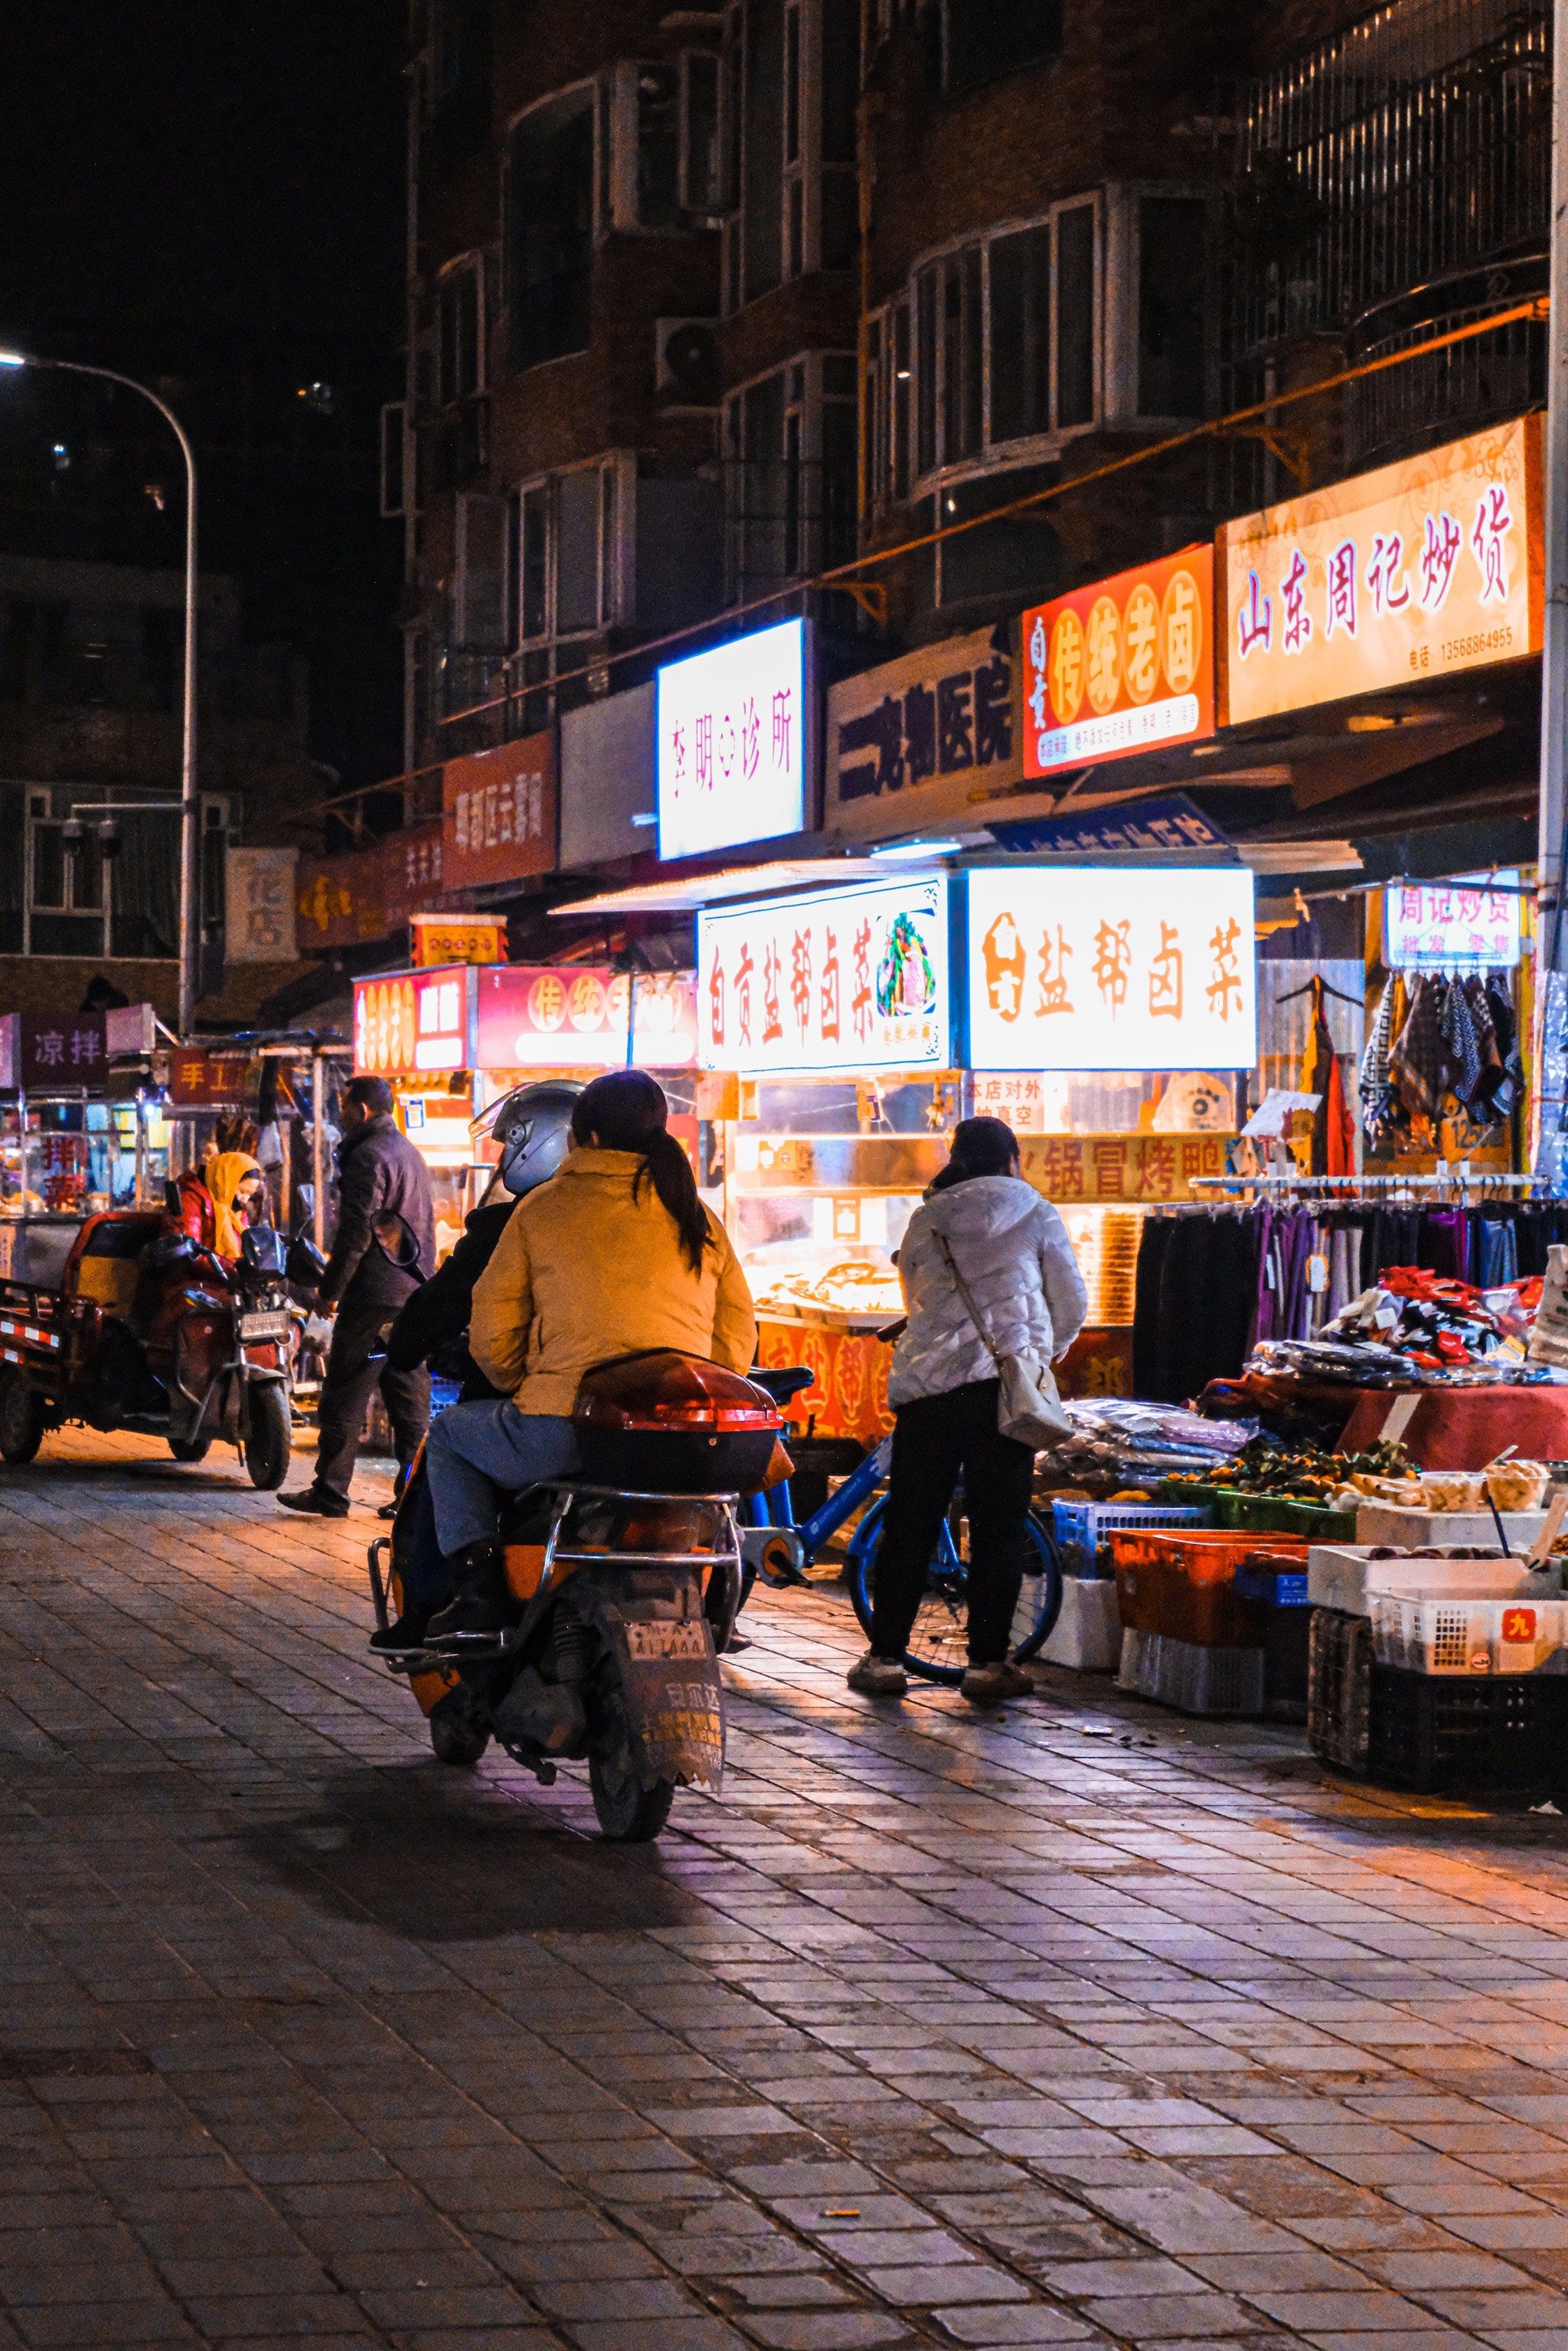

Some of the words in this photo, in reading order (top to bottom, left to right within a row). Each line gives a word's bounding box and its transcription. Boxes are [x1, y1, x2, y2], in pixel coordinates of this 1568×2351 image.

[1237, 486, 1511, 657] 山东周记炒货
[1054, 582, 1196, 716] 传统老卤
[1442, 626, 1513, 661] 13568864955
[1399, 885, 1511, 924] 周记炒货
[1403, 934, 1446, 954] 批发
[1468, 934, 1510, 954] 零售
[709, 916, 874, 1048] 自贡盐帮卤菜
[34, 1029, 102, 1066] 凉拌
[1023, 1138, 1220, 1199] 锅冒烤鸭
[1508, 1613, 1530, 1638] 九
